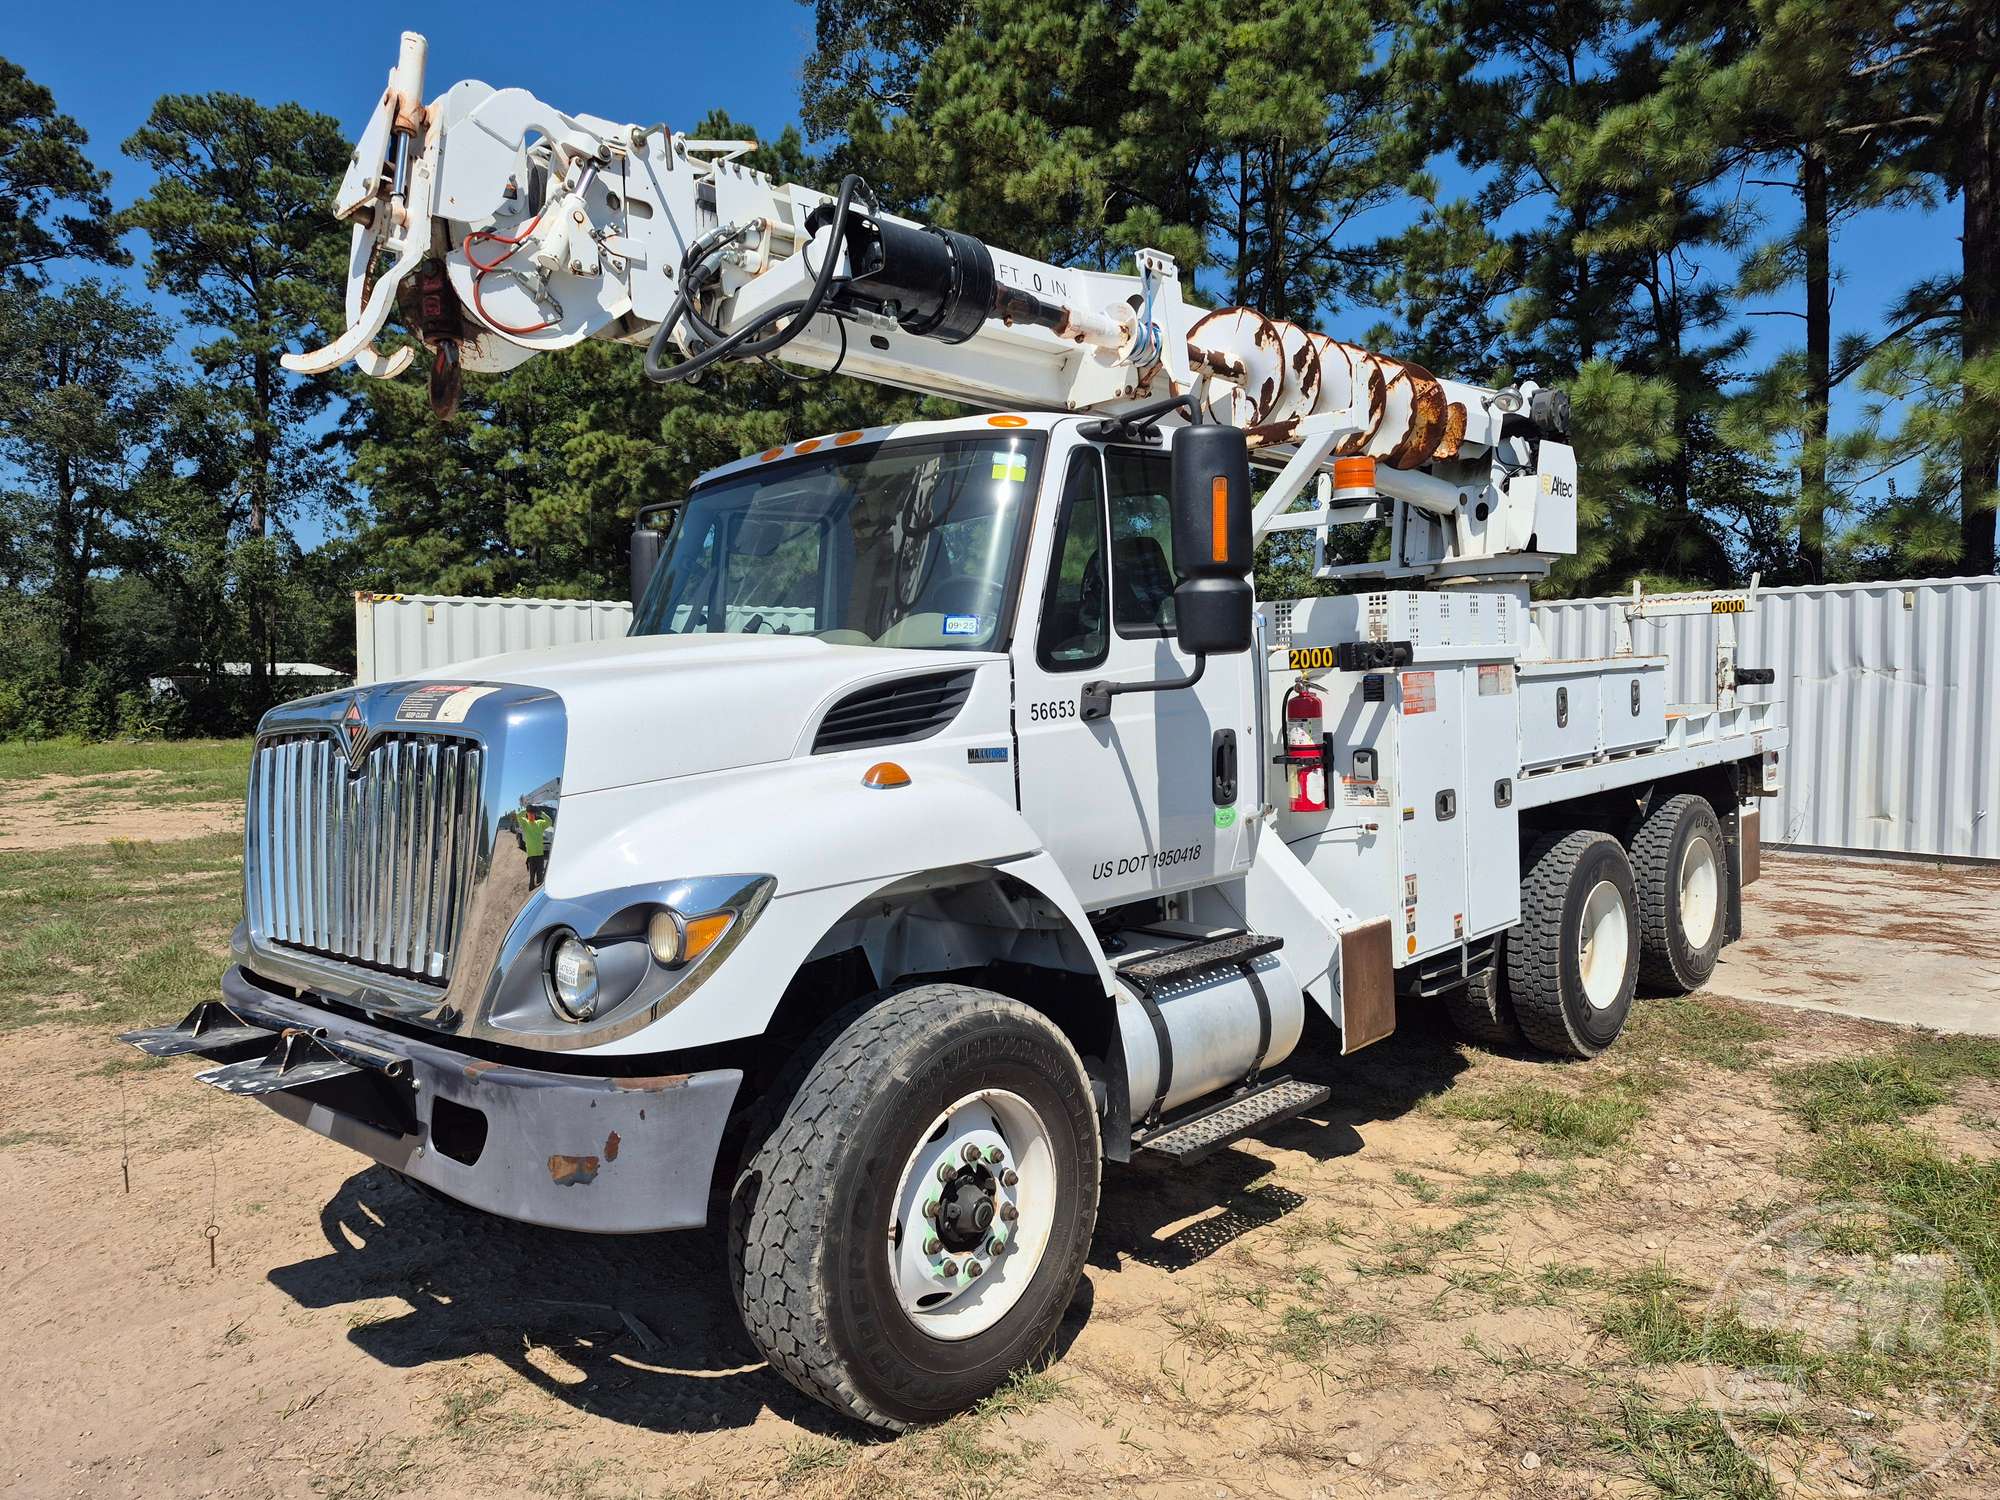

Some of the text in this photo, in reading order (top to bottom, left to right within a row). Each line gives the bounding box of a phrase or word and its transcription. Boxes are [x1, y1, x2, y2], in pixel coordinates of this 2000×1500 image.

[999, 264, 1024, 285] FT.
[1051, 279, 1072, 299] IN.
[1551, 475, 1573, 498] Altec
[1712, 600, 1745, 613] 2000
[1289, 648, 1333, 669] 2000
[1030, 700, 1076, 721] 56653
[1092, 844, 1202, 880] US DOT 1950418
